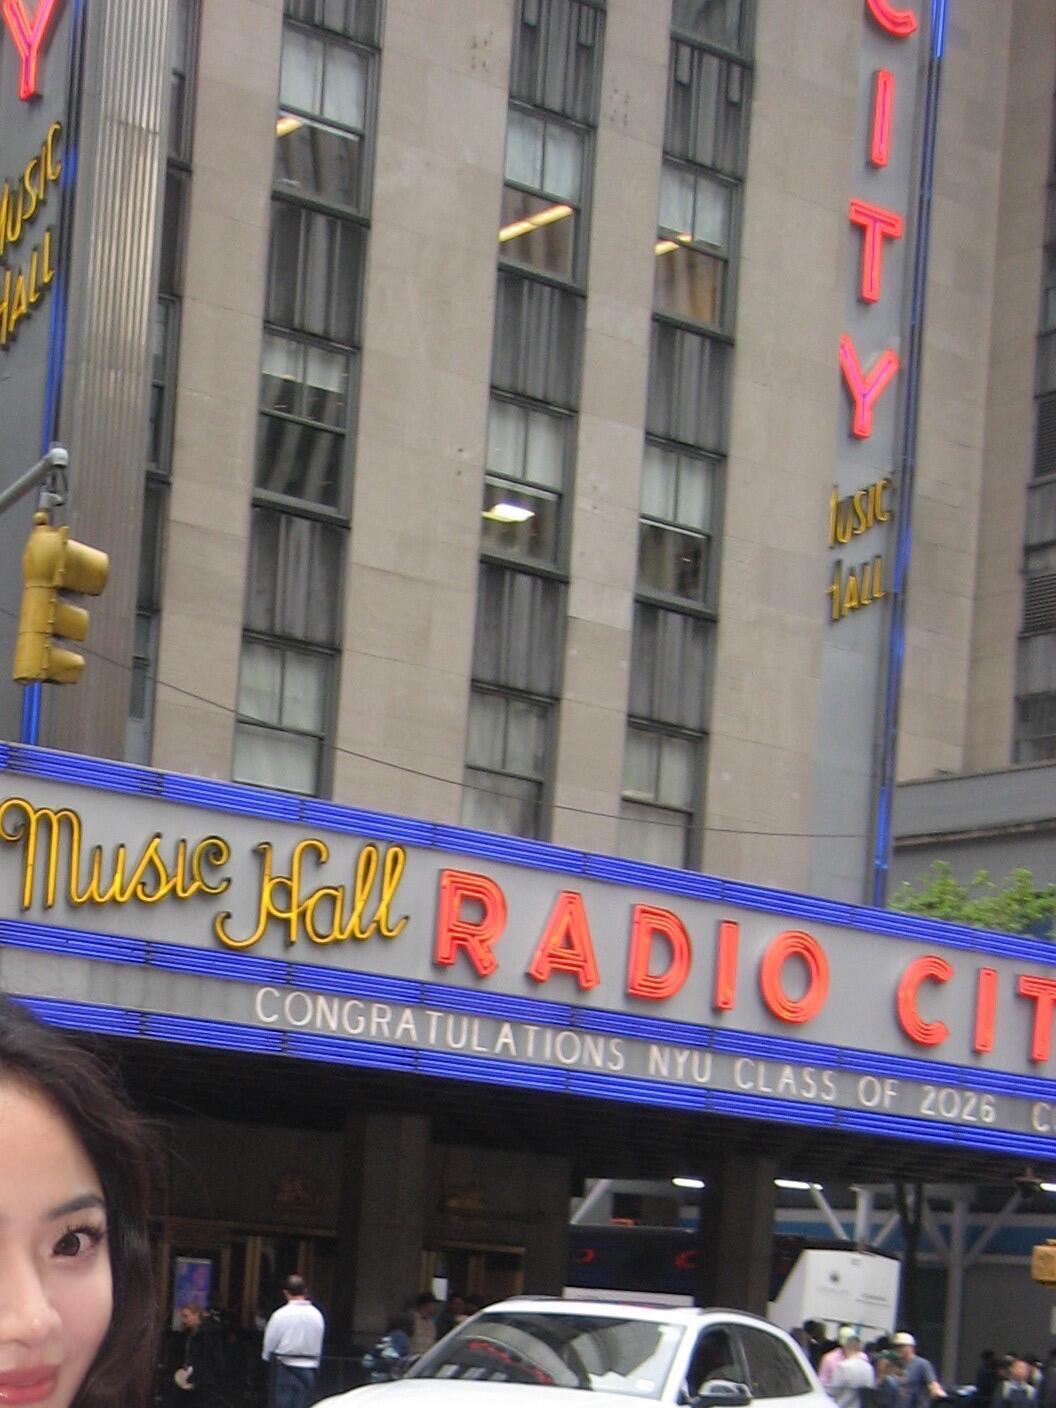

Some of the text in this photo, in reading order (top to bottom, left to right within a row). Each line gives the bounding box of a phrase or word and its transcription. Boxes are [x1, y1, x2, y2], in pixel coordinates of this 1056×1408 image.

[214, 837, 411, 950] Hall
[435, 868, 831, 1026] RADIO
[255, 987, 1056, 1133] CONGRATULATIONS NYU CLASS OF 2026 C
